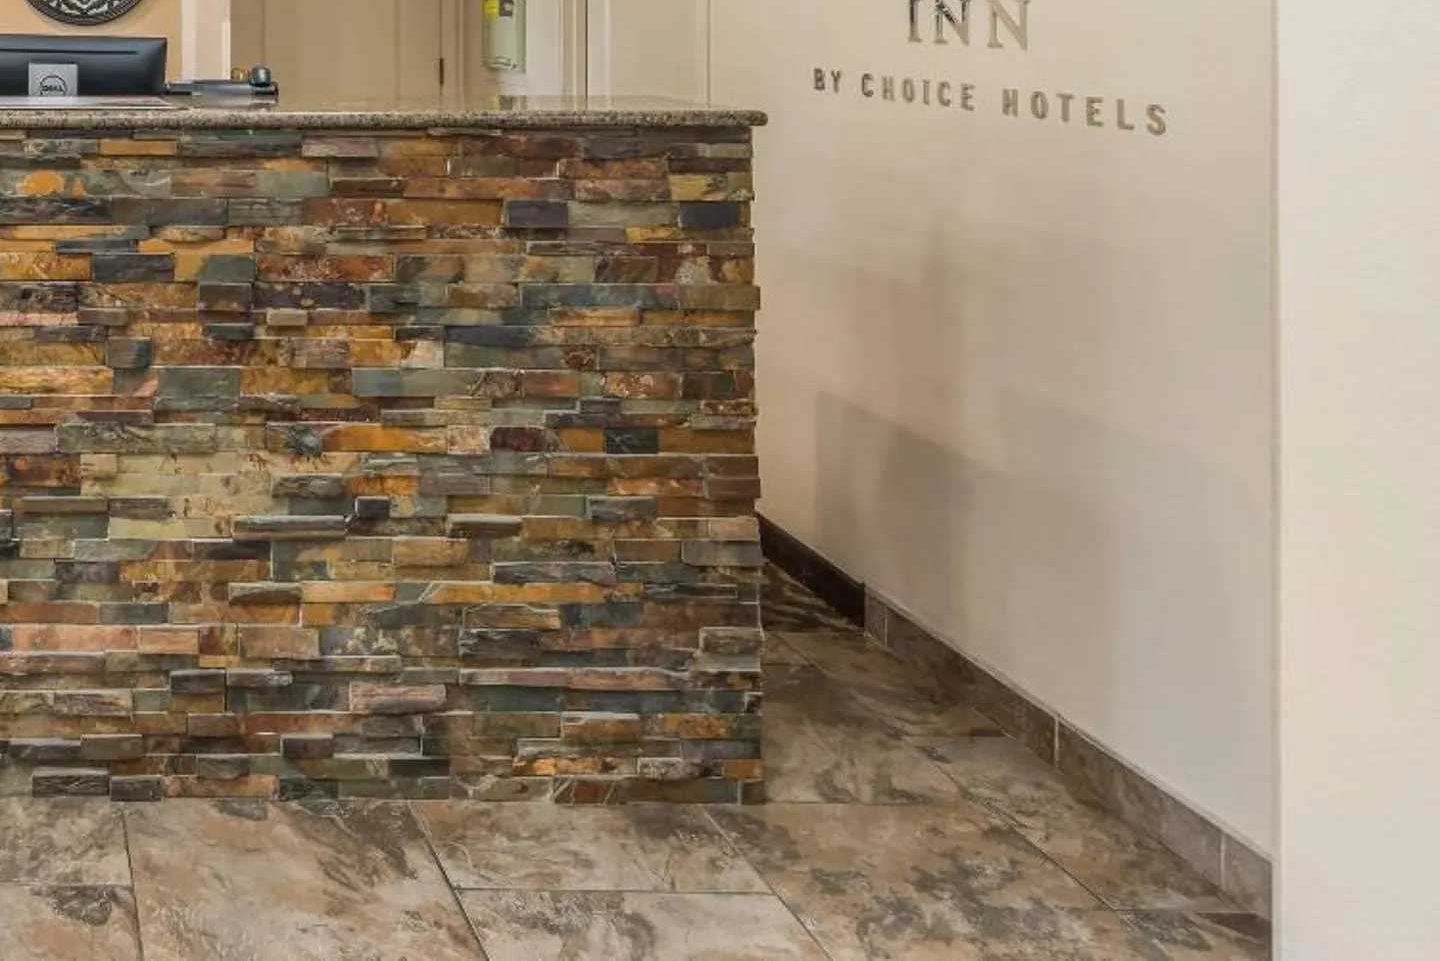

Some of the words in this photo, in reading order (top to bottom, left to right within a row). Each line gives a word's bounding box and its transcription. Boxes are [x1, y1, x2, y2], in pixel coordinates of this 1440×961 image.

[813, 67, 842, 93] BY
[861, 72, 976, 112] CHOICE
[1001, 88, 1167, 136] HOTELS
